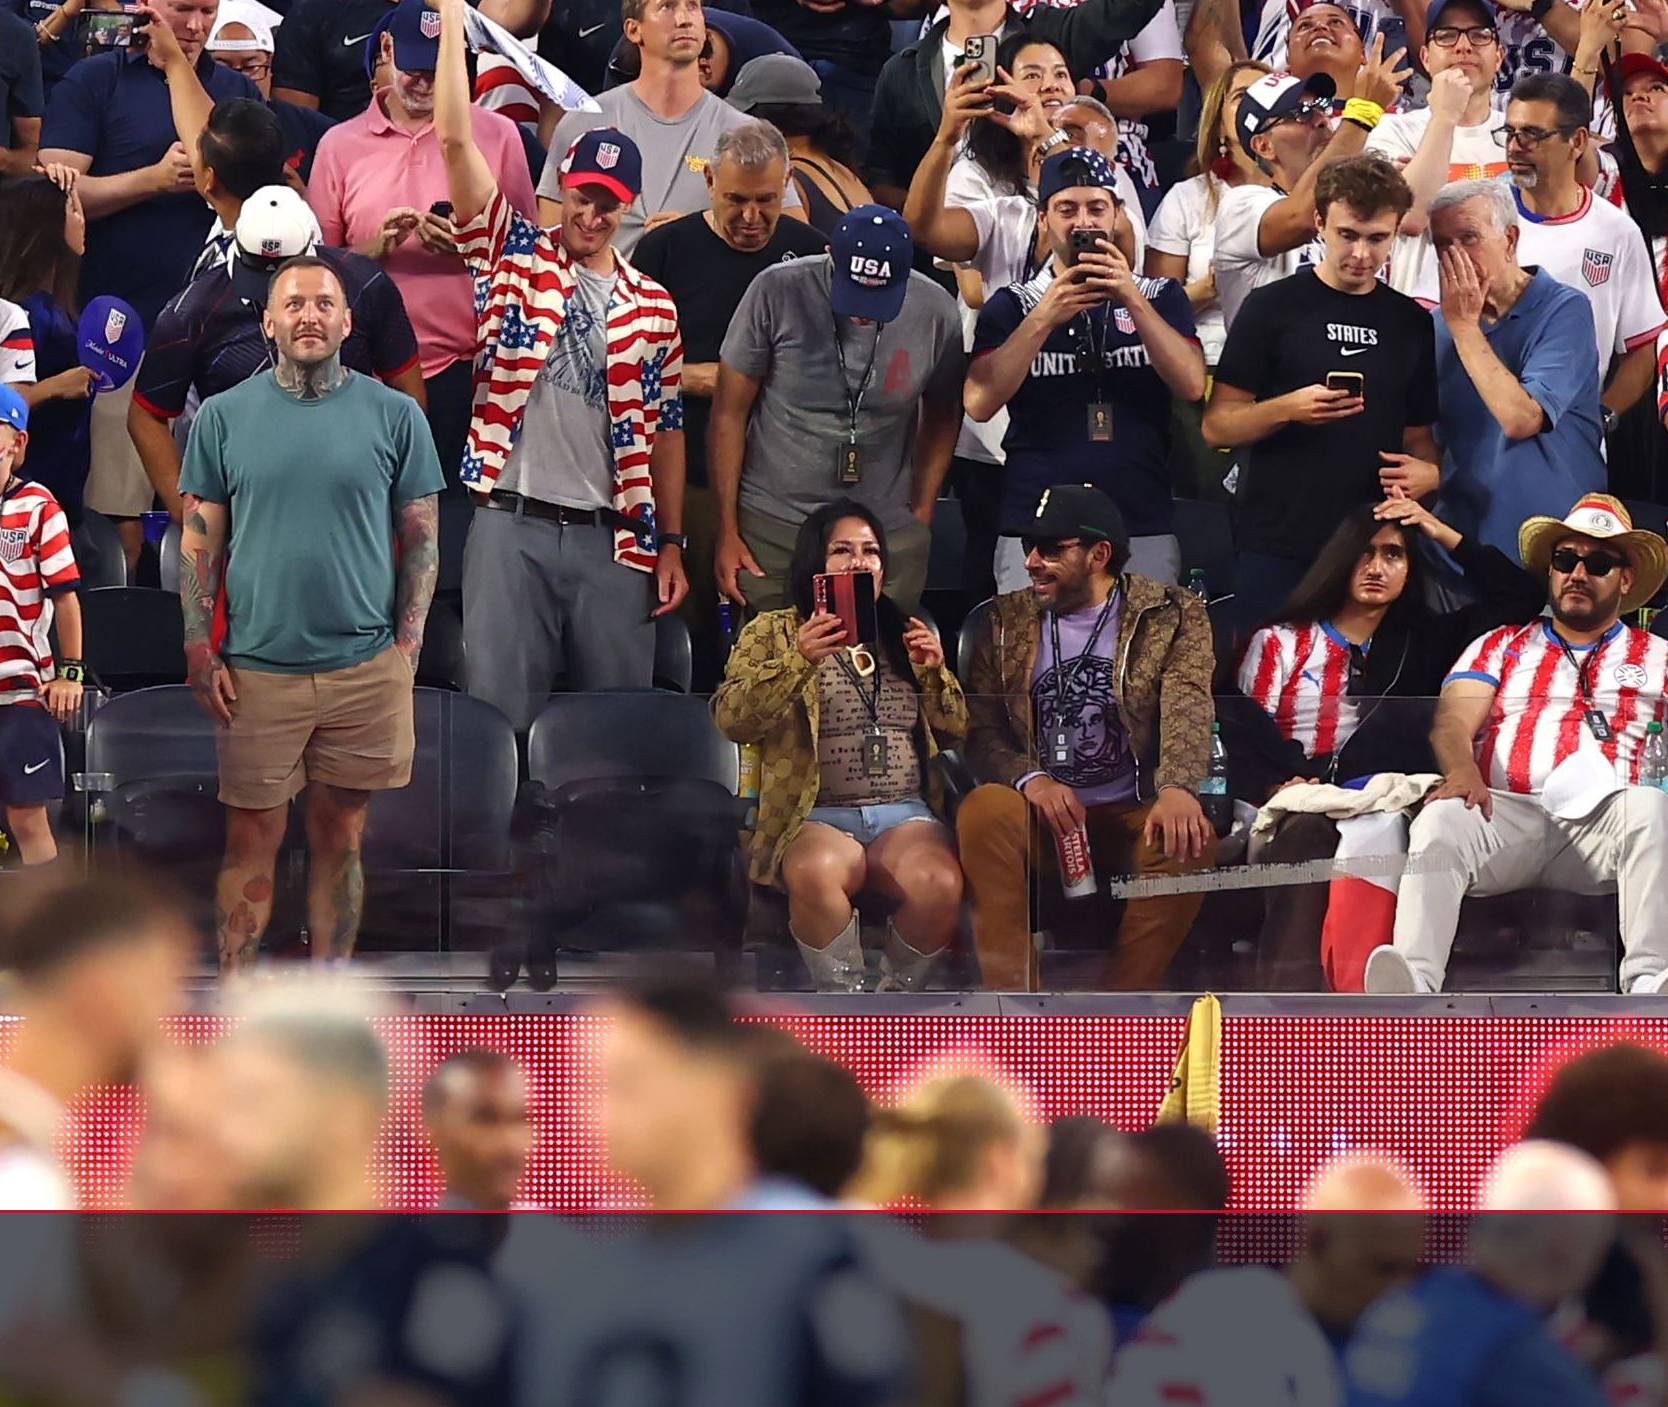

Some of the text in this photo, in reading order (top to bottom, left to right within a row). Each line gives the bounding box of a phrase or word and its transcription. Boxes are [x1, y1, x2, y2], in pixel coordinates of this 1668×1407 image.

[850, 255, 891, 279] USA
[1327, 323, 1378, 345] STATES
[108, 351, 128, 369] ULTRA
[1031, 352, 1076, 378] UNIT
[1062, 837, 1076, 877] ARTOIS
[1072, 833, 1085, 873] STELLA
